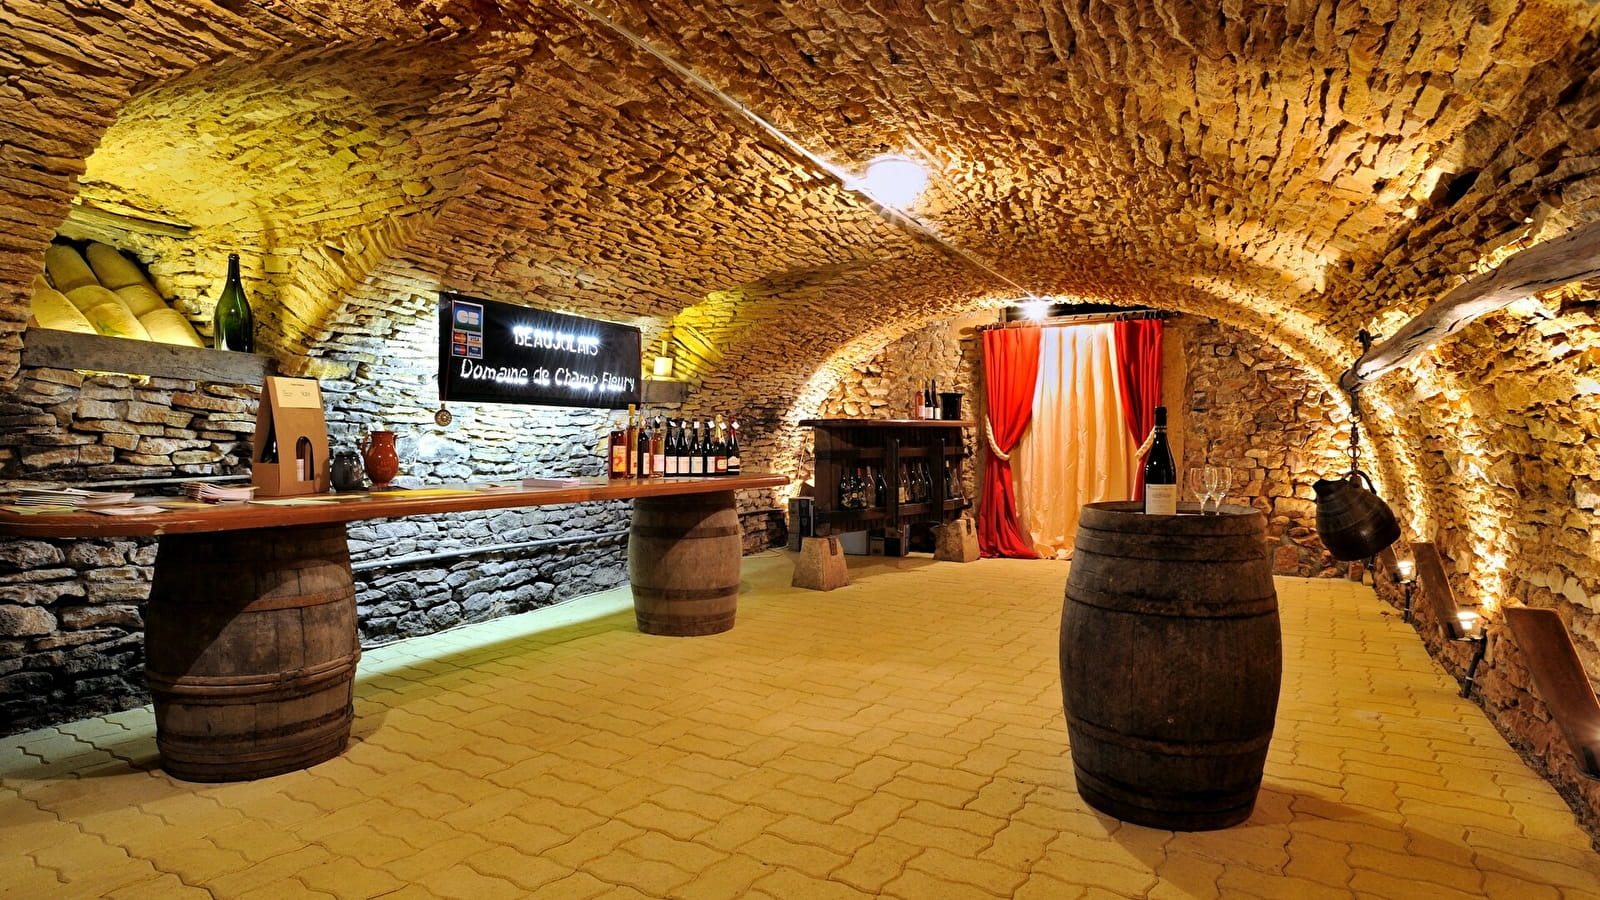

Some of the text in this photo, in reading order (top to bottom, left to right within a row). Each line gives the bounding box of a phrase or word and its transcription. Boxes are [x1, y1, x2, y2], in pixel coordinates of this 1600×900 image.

[514, 325, 599, 356] BEAUJOLAIS
[460, 359, 635, 392] Domaine de Champ Fleury
